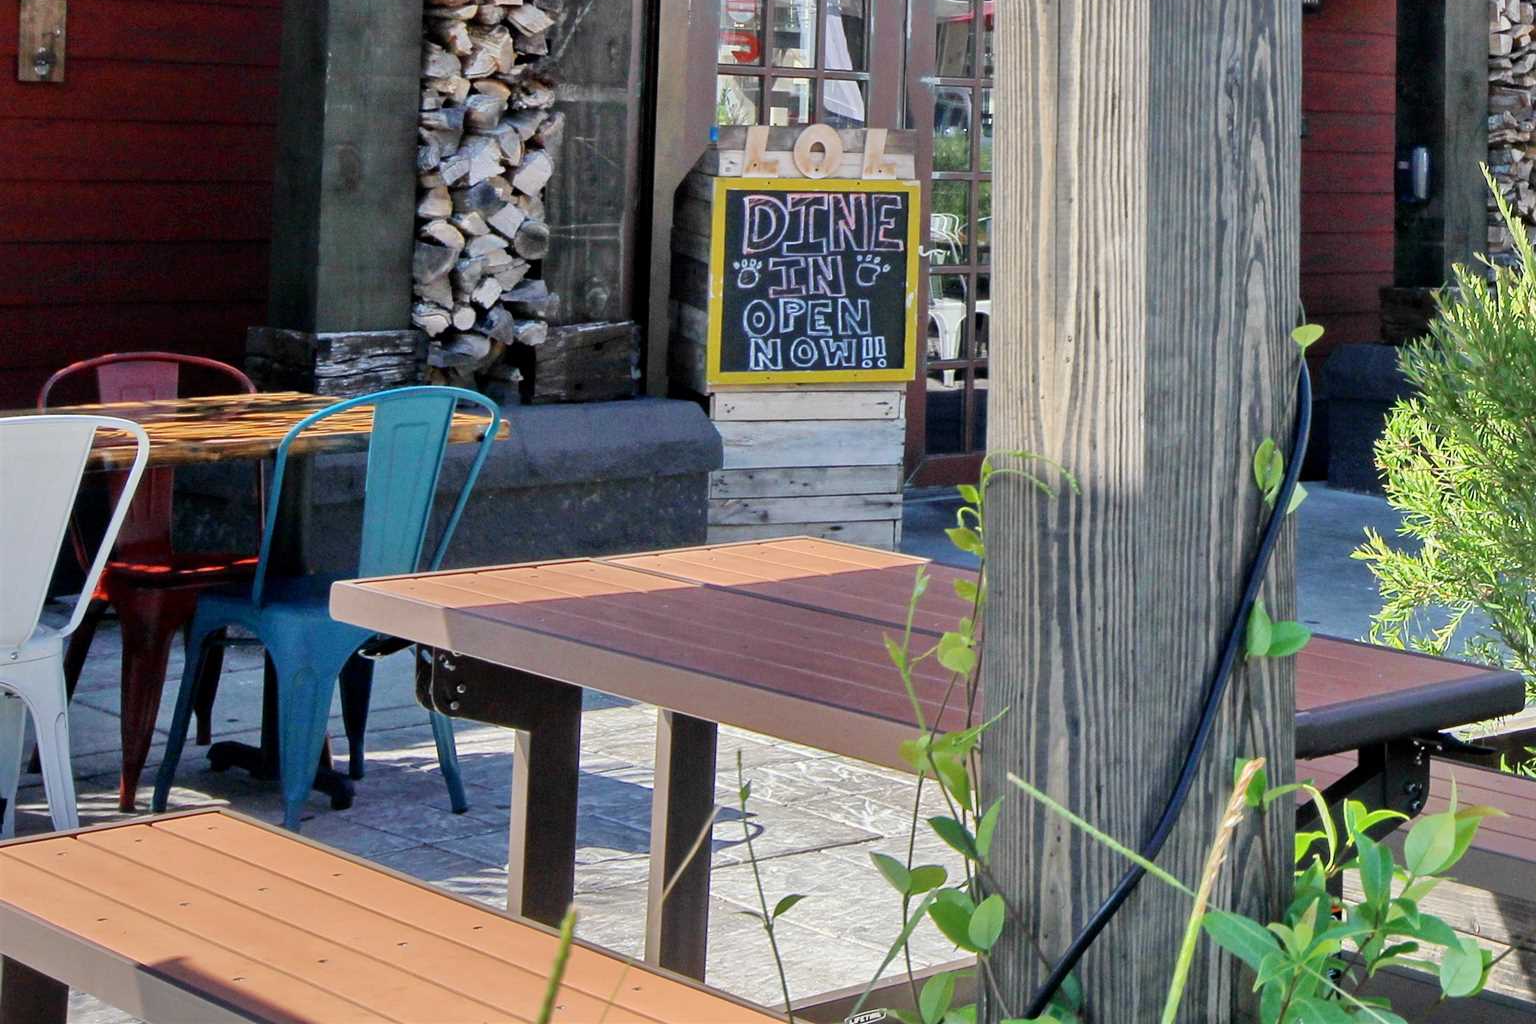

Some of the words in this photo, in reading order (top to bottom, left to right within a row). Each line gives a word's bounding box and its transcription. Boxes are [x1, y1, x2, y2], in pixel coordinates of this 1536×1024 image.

[742, 123, 897, 180] LOL
[742, 193, 904, 256] DINE
[768, 255, 847, 298] IN
[743, 298, 872, 338] OPEN
[750, 336, 887, 370] NOW!!
